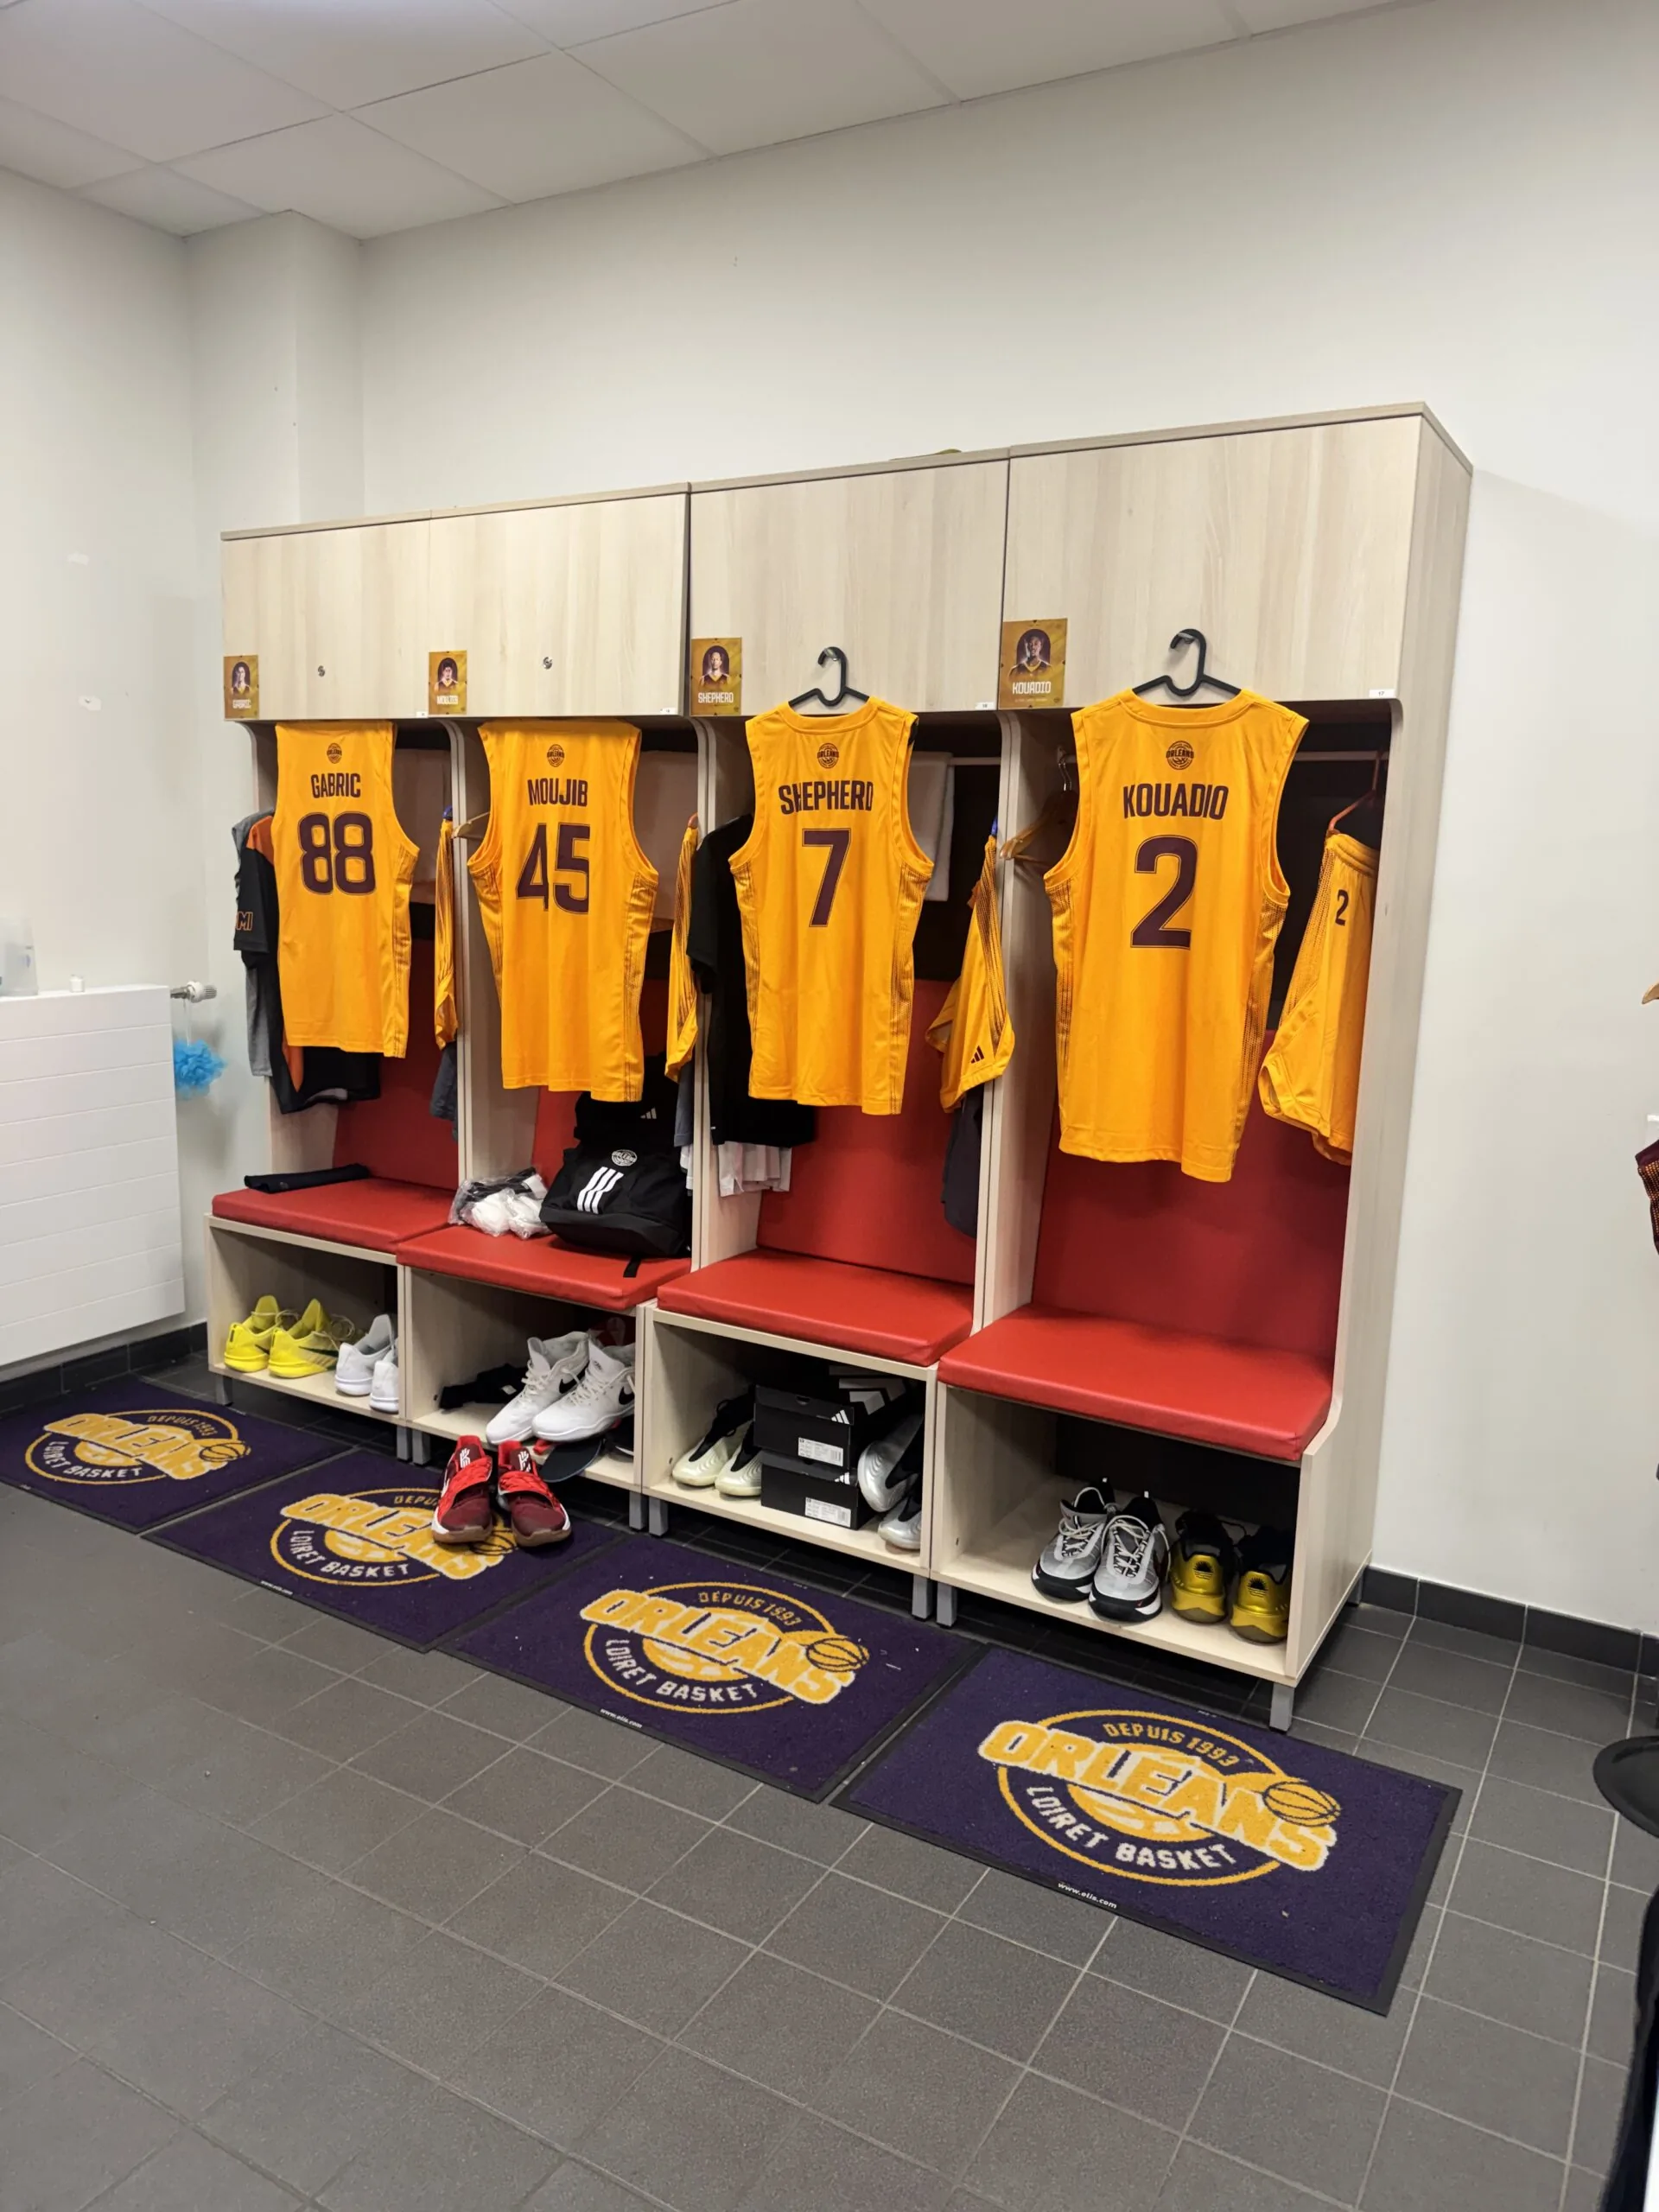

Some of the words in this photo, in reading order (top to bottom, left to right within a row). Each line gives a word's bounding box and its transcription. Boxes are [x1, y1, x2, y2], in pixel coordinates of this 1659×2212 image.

[697, 692, 734, 703] SHEPHERD
[1012, 681, 1052, 695] KOUADIO
[311, 772, 360, 798] GABRIC
[527, 778, 588, 807] MOUJIB
[779, 779, 874, 815] SHEPHERD
[1123, 783, 1229, 820] KOUADIO
[297, 810, 377, 896] 88
[516, 822, 590, 915] 45
[802, 828, 851, 927] 7
[1130, 835, 1198, 950] 2
[1335, 889, 1349, 926] 2
[43, 1413, 229, 1480] ORLEANS
[63, 1466, 143, 1479] BASKET
[290, 1529, 327, 1566] LOIRET
[320, 1562, 410, 1578] BASKET
[698, 1592, 765, 1609] DEPUIS
[762, 1603, 802, 1626] 1993
[580, 1589, 855, 1705] ORLEANS
[606, 1639, 658, 1686] LOIRET
[655, 1680, 759, 1702] BASKET
[1103, 1723, 1184, 1744] DEPUIS
[1187, 1737, 1240, 1767] 1993
[977, 1720, 1337, 1872] ORLEANS
[1026, 1785, 1109, 1848] LOIRET
[1115, 1842, 1237, 1871] BASKET
[1058, 1883, 1117, 1910] www.elis.com
